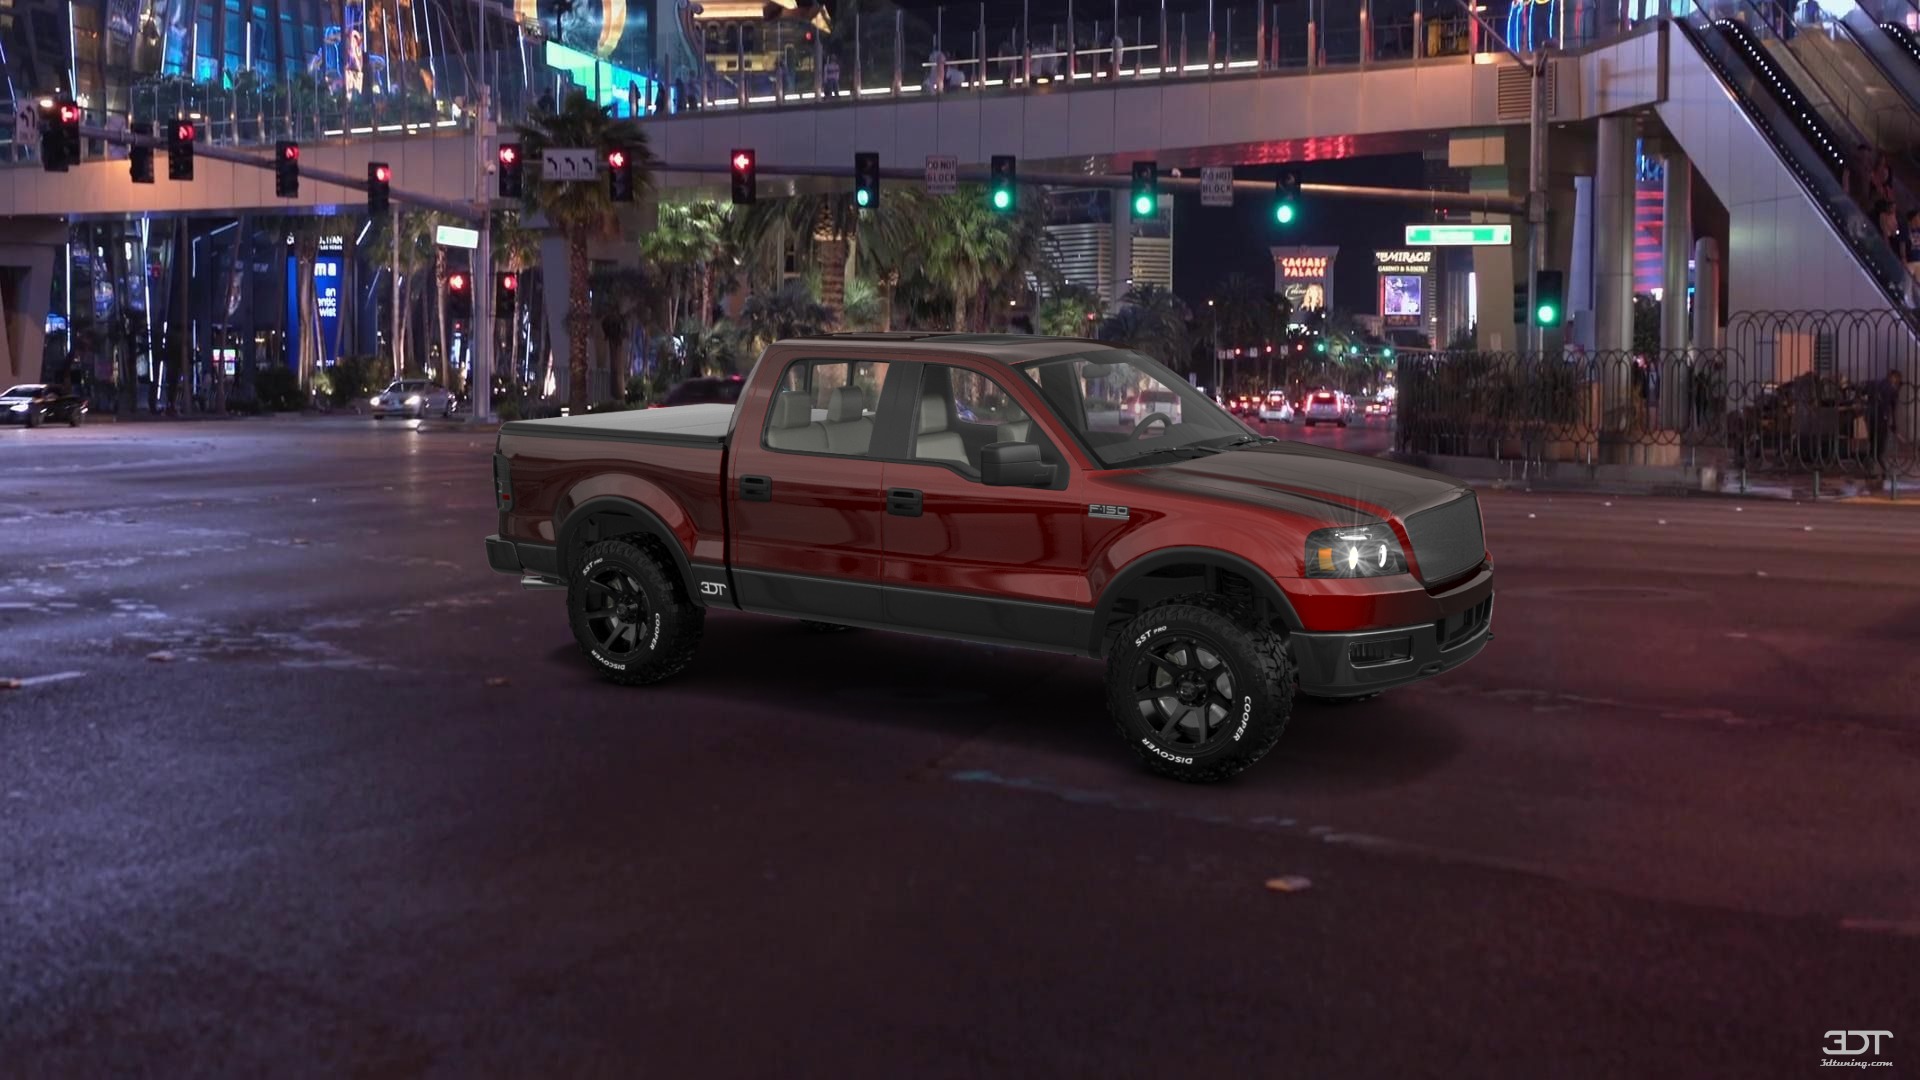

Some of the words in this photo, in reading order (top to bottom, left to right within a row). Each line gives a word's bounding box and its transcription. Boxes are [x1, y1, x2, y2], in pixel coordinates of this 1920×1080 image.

[940, 159, 955, 170] NOT
[927, 172, 956, 183] BLOCK
[1202, 183, 1231, 193] BLOCK
[1281, 257, 1327, 267] CAESARS
[1382, 251, 1431, 263] MIRAGE
[1284, 267, 1324, 277] PALACE
[582, 561, 594, 576] SST
[700, 581, 727, 596] 3DT
[649, 612, 661, 651] COOPER
[1134, 629, 1152, 648] SST
[1153, 625, 1167, 635] PRO
[591, 649, 626, 671] DISCOVER
[1233, 695, 1252, 742] COOPER
[1141, 737, 1193, 765] DISCOVER
